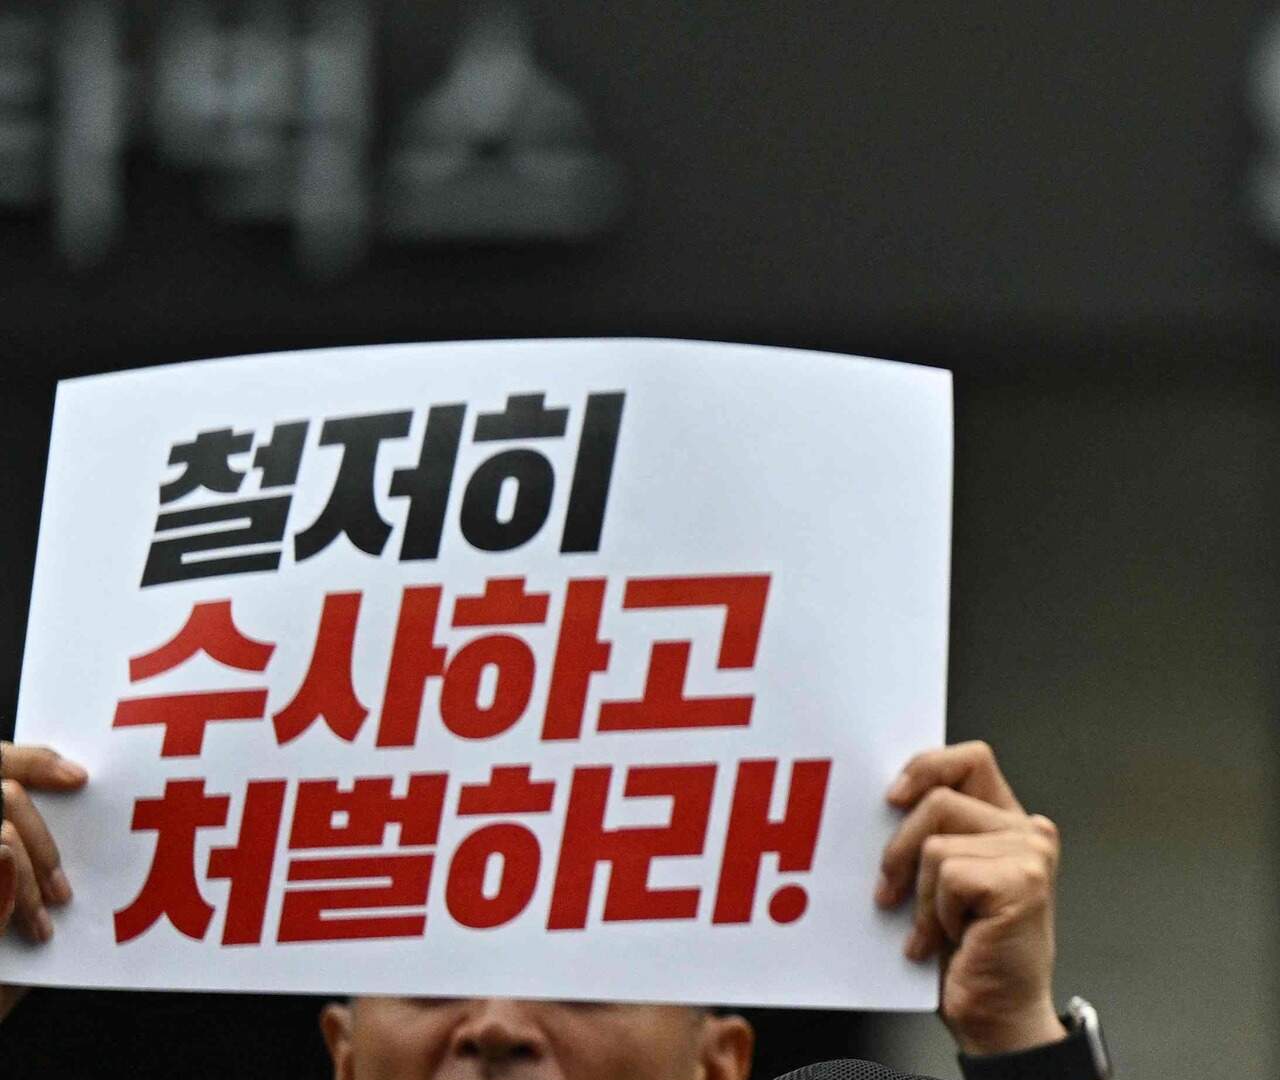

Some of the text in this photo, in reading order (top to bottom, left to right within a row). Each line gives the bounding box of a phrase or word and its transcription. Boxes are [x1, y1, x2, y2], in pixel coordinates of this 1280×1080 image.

[141, 390, 626, 588] 철저히
[112, 573, 771, 757] 수사하고
[114, 758, 831, 947] 처벌하라!
